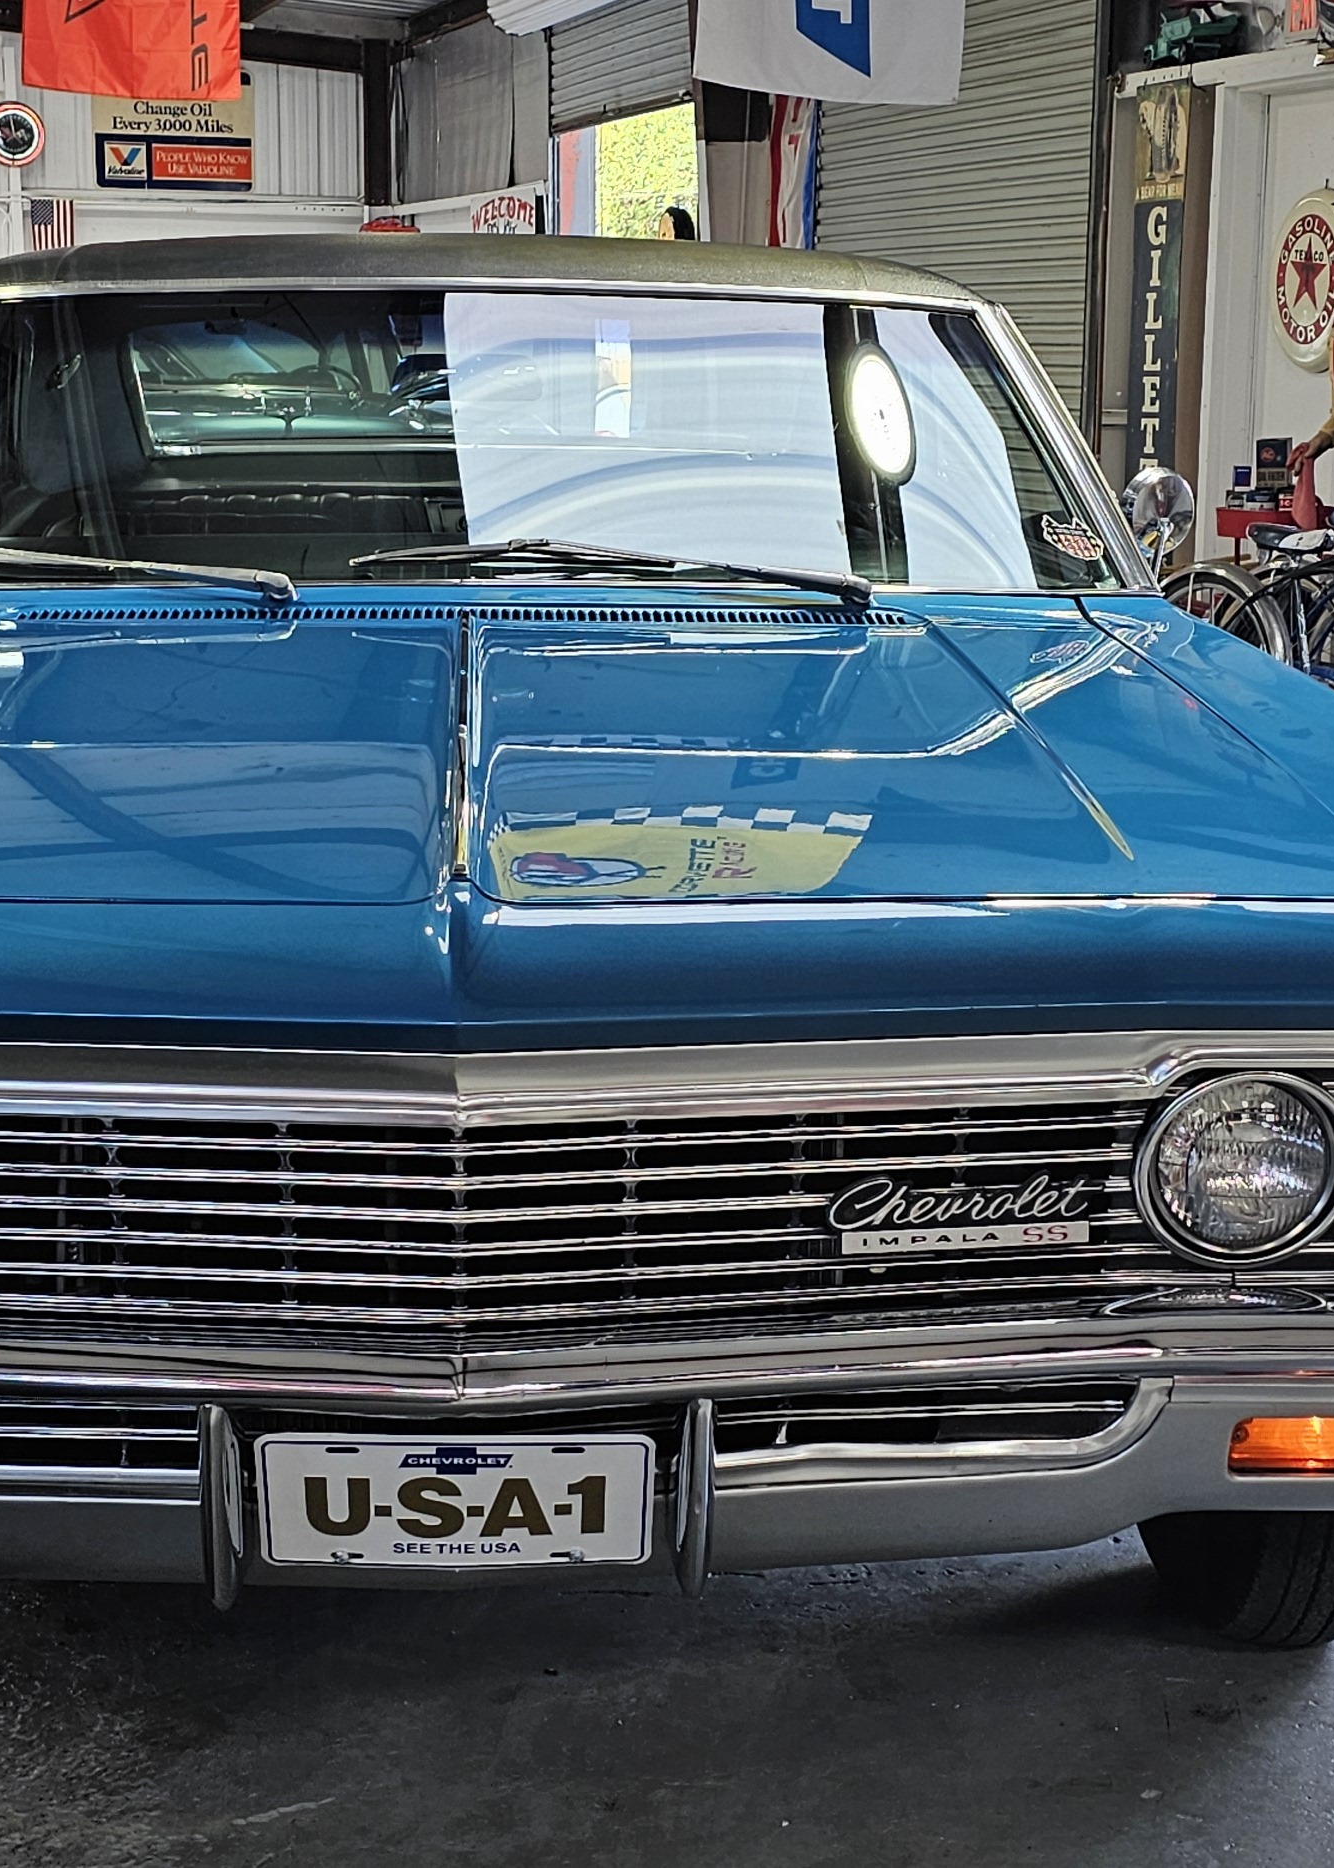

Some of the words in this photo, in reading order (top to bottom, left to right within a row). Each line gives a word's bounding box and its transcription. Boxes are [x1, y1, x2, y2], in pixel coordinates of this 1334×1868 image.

[134, 101, 187, 117] Change
[190, 103, 212, 117] Oil
[112, 116, 152, 133] Every
[154, 118, 192, 133] 3,000
[195, 119, 234, 133] Miles
[156, 151, 191, 162] PEOPLE
[194, 153, 217, 163] WHO
[219, 153, 248, 165] KNOW
[108, 166, 145, 176] Valvoline
[168, 164, 186, 174] USE
[187, 164, 236, 176] VALVOLINE
[471, 195, 534, 234] WELCOME
[1293, 249, 1325, 263] TEXACO
[1277, 287, 1316, 343] MOTOR
[829, 1174, 1089, 1230] Chevrolet
[862, 1232, 1000, 1247] IMPALA
[1022, 1225, 1068, 1243] SS
[407, 1455, 509, 1466] CHEVROLET
[304, 1475, 607, 1539] U-S-A-1
[393, 1543, 432, 1554] SEE
[437, 1543, 476, 1554] THE
[480, 1543, 521, 1554] USA
